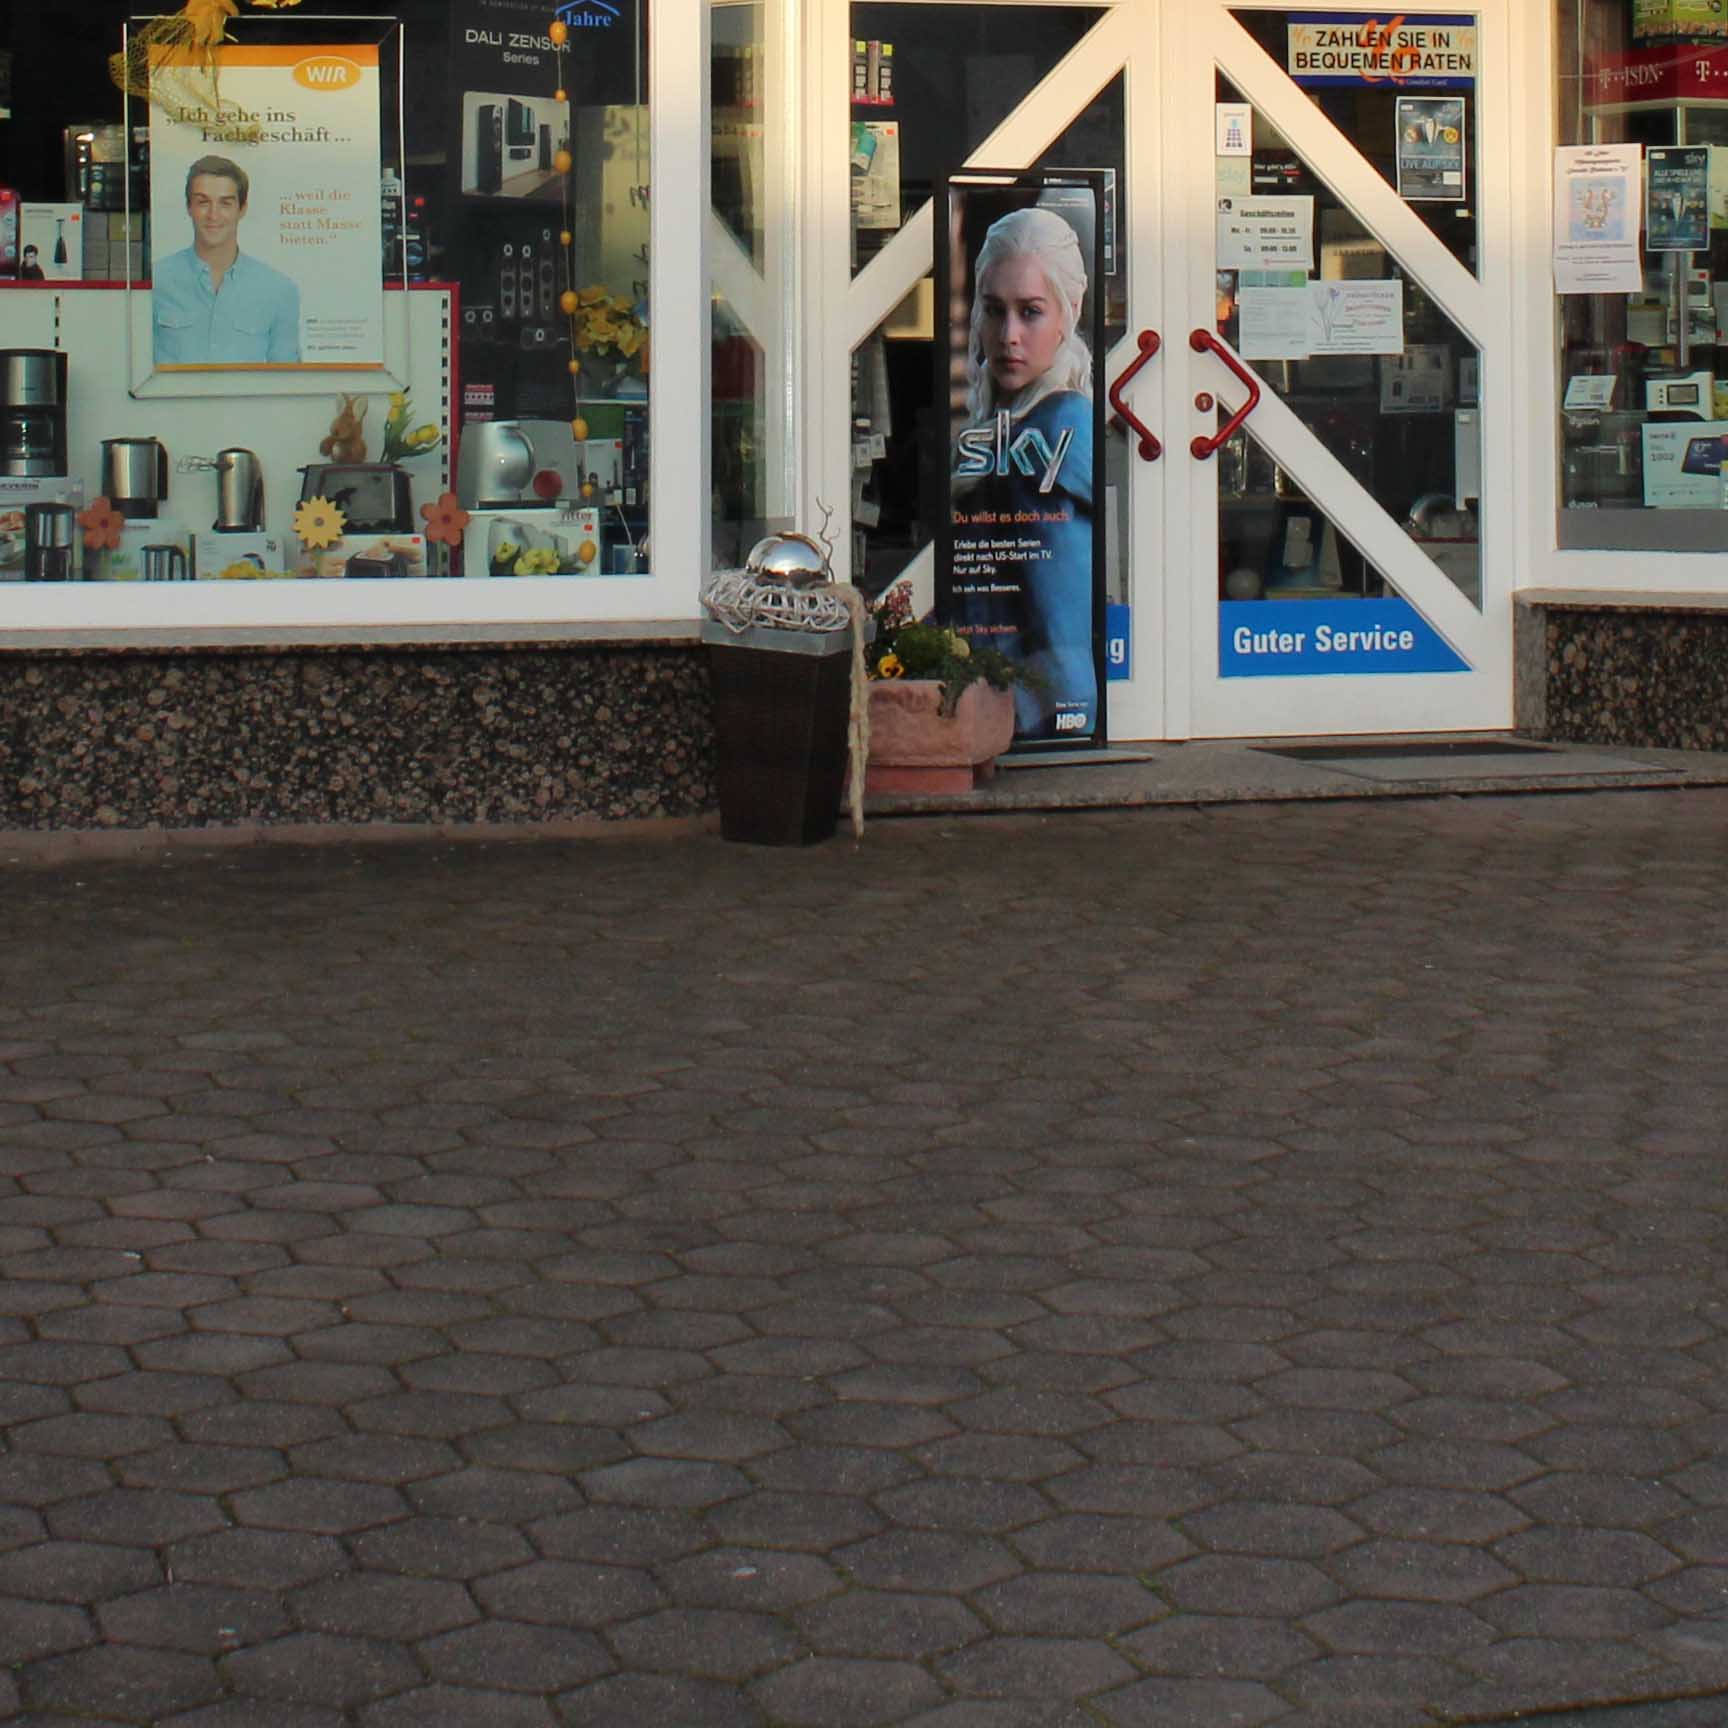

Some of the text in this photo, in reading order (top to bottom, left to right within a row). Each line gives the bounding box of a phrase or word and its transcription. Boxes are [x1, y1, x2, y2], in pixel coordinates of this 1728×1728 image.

[563, 10, 612, 28] Jahre
[465, 29, 503, 45] DALI
[1316, 31, 1451, 49] ZAHLEN SIE IN
[503, 52, 540, 65] Series
[1295, 52, 1472, 71] BEQUEMEN RATEN
[305, 66, 347, 83] WIR
[215, 108, 260, 128] gehe
[267, 107, 296, 122] ins
[202, 126, 330, 146] Fachgeschäft
[955, 409, 1073, 493] sky
[953, 511, 968, 524] Du
[971, 510, 996, 523] willst
[999, 513, 1012, 523] es
[1014, 510, 1040, 522] doch
[1234, 624, 1413, 653] Guter Service
[1056, 713, 1086, 730] HBO
